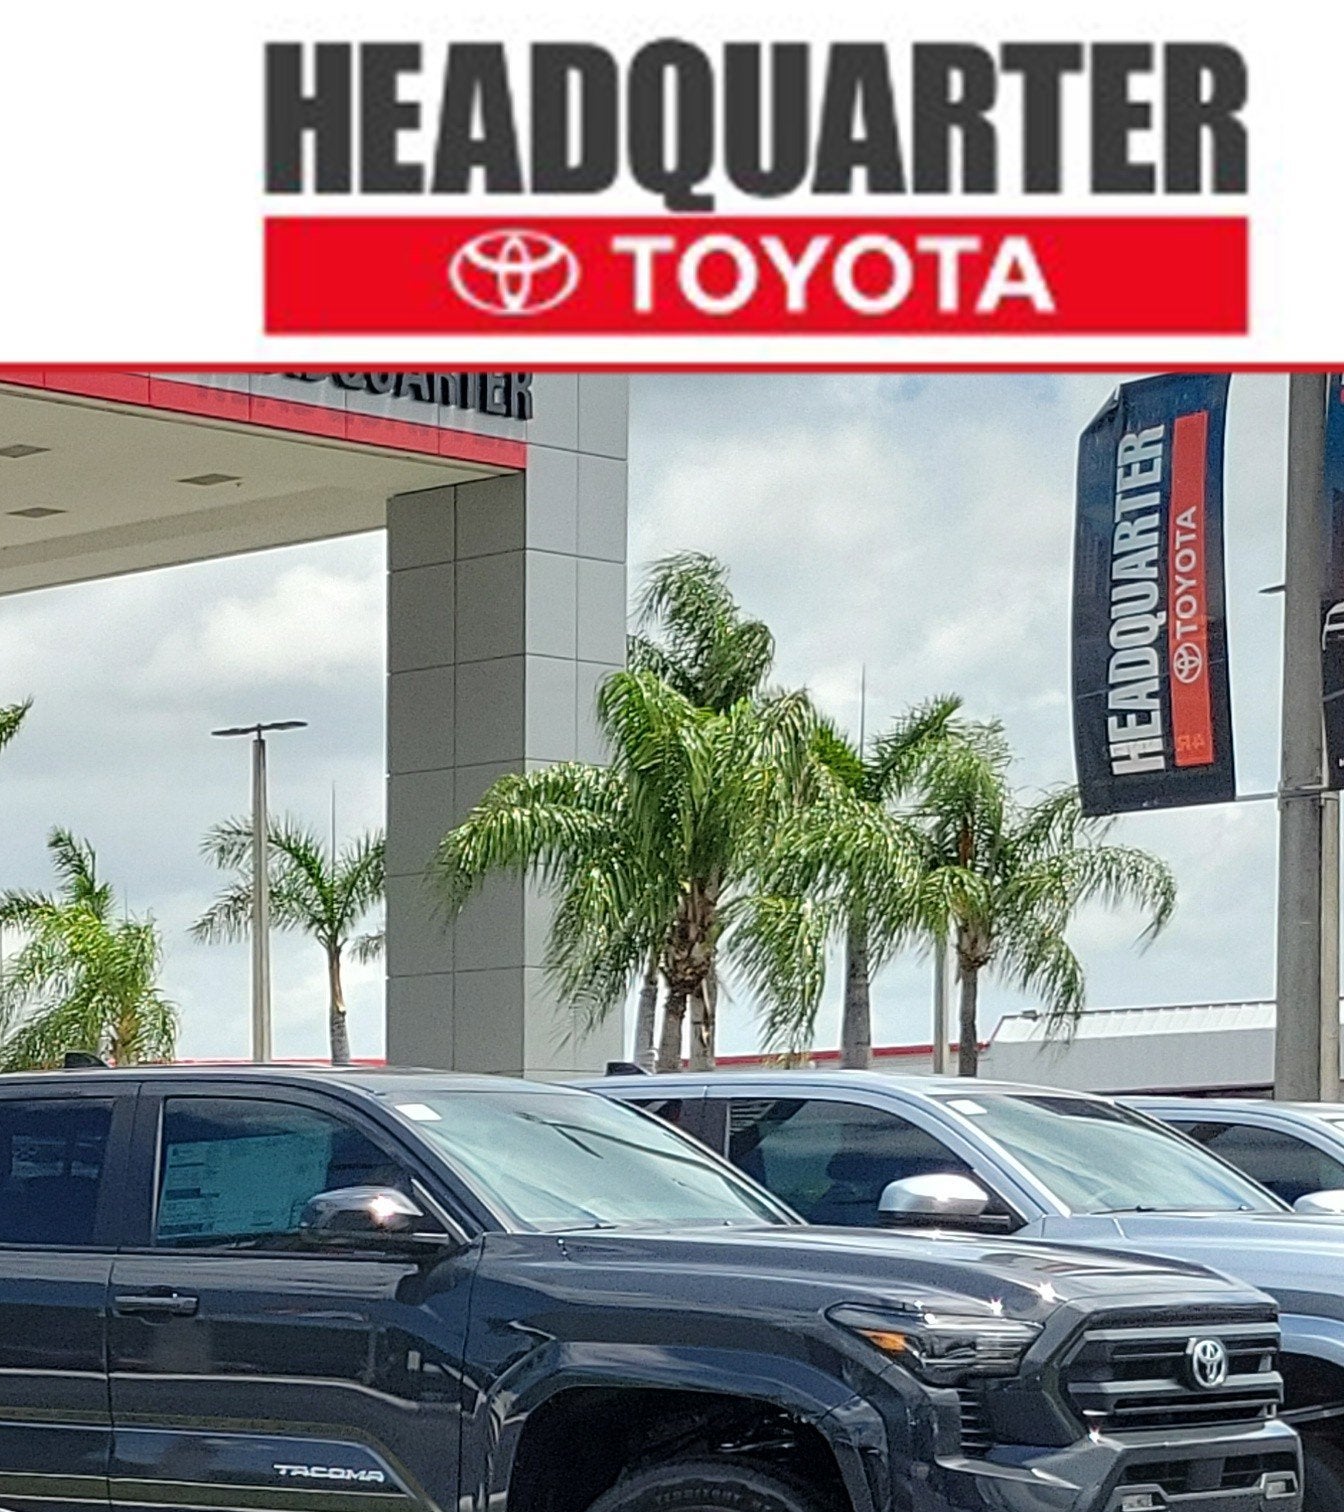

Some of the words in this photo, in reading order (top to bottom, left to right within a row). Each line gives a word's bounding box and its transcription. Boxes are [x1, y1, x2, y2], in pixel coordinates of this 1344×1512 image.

[1107, 424, 1166, 776] HEADQUARTER
[1175, 505, 1198, 640] TOYOTA
[273, 1464, 385, 1483] TACOMA
